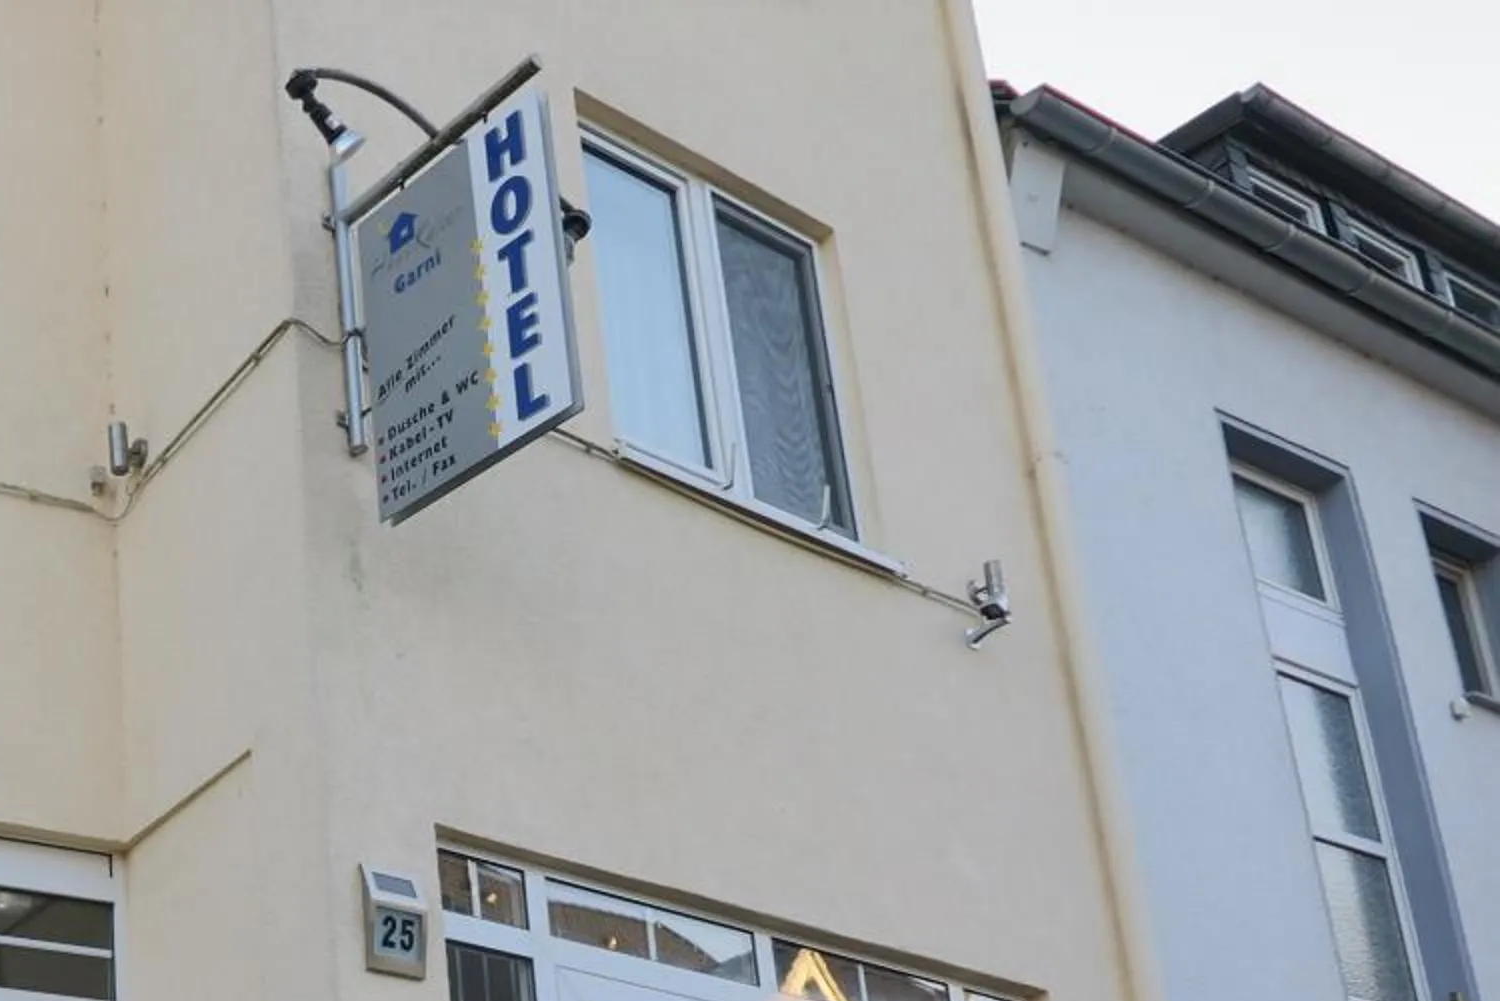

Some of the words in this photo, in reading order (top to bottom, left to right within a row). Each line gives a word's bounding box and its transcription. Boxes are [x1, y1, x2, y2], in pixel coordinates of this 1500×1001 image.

[395, 246, 441, 293] Garni
[484, 110, 550, 421] HOTEL
[378, 370, 402, 400] Alle
[405, 314, 455, 370] Zimmer
[387, 402, 435, 440] Dusche
[441, 389, 451, 405] &
[455, 369, 479, 395] WC
[390, 435, 447, 481] Internet
[391, 479, 417, 501] Tel.
[432, 454, 456, 476] Fax
[381, 914, 415, 952] 25
